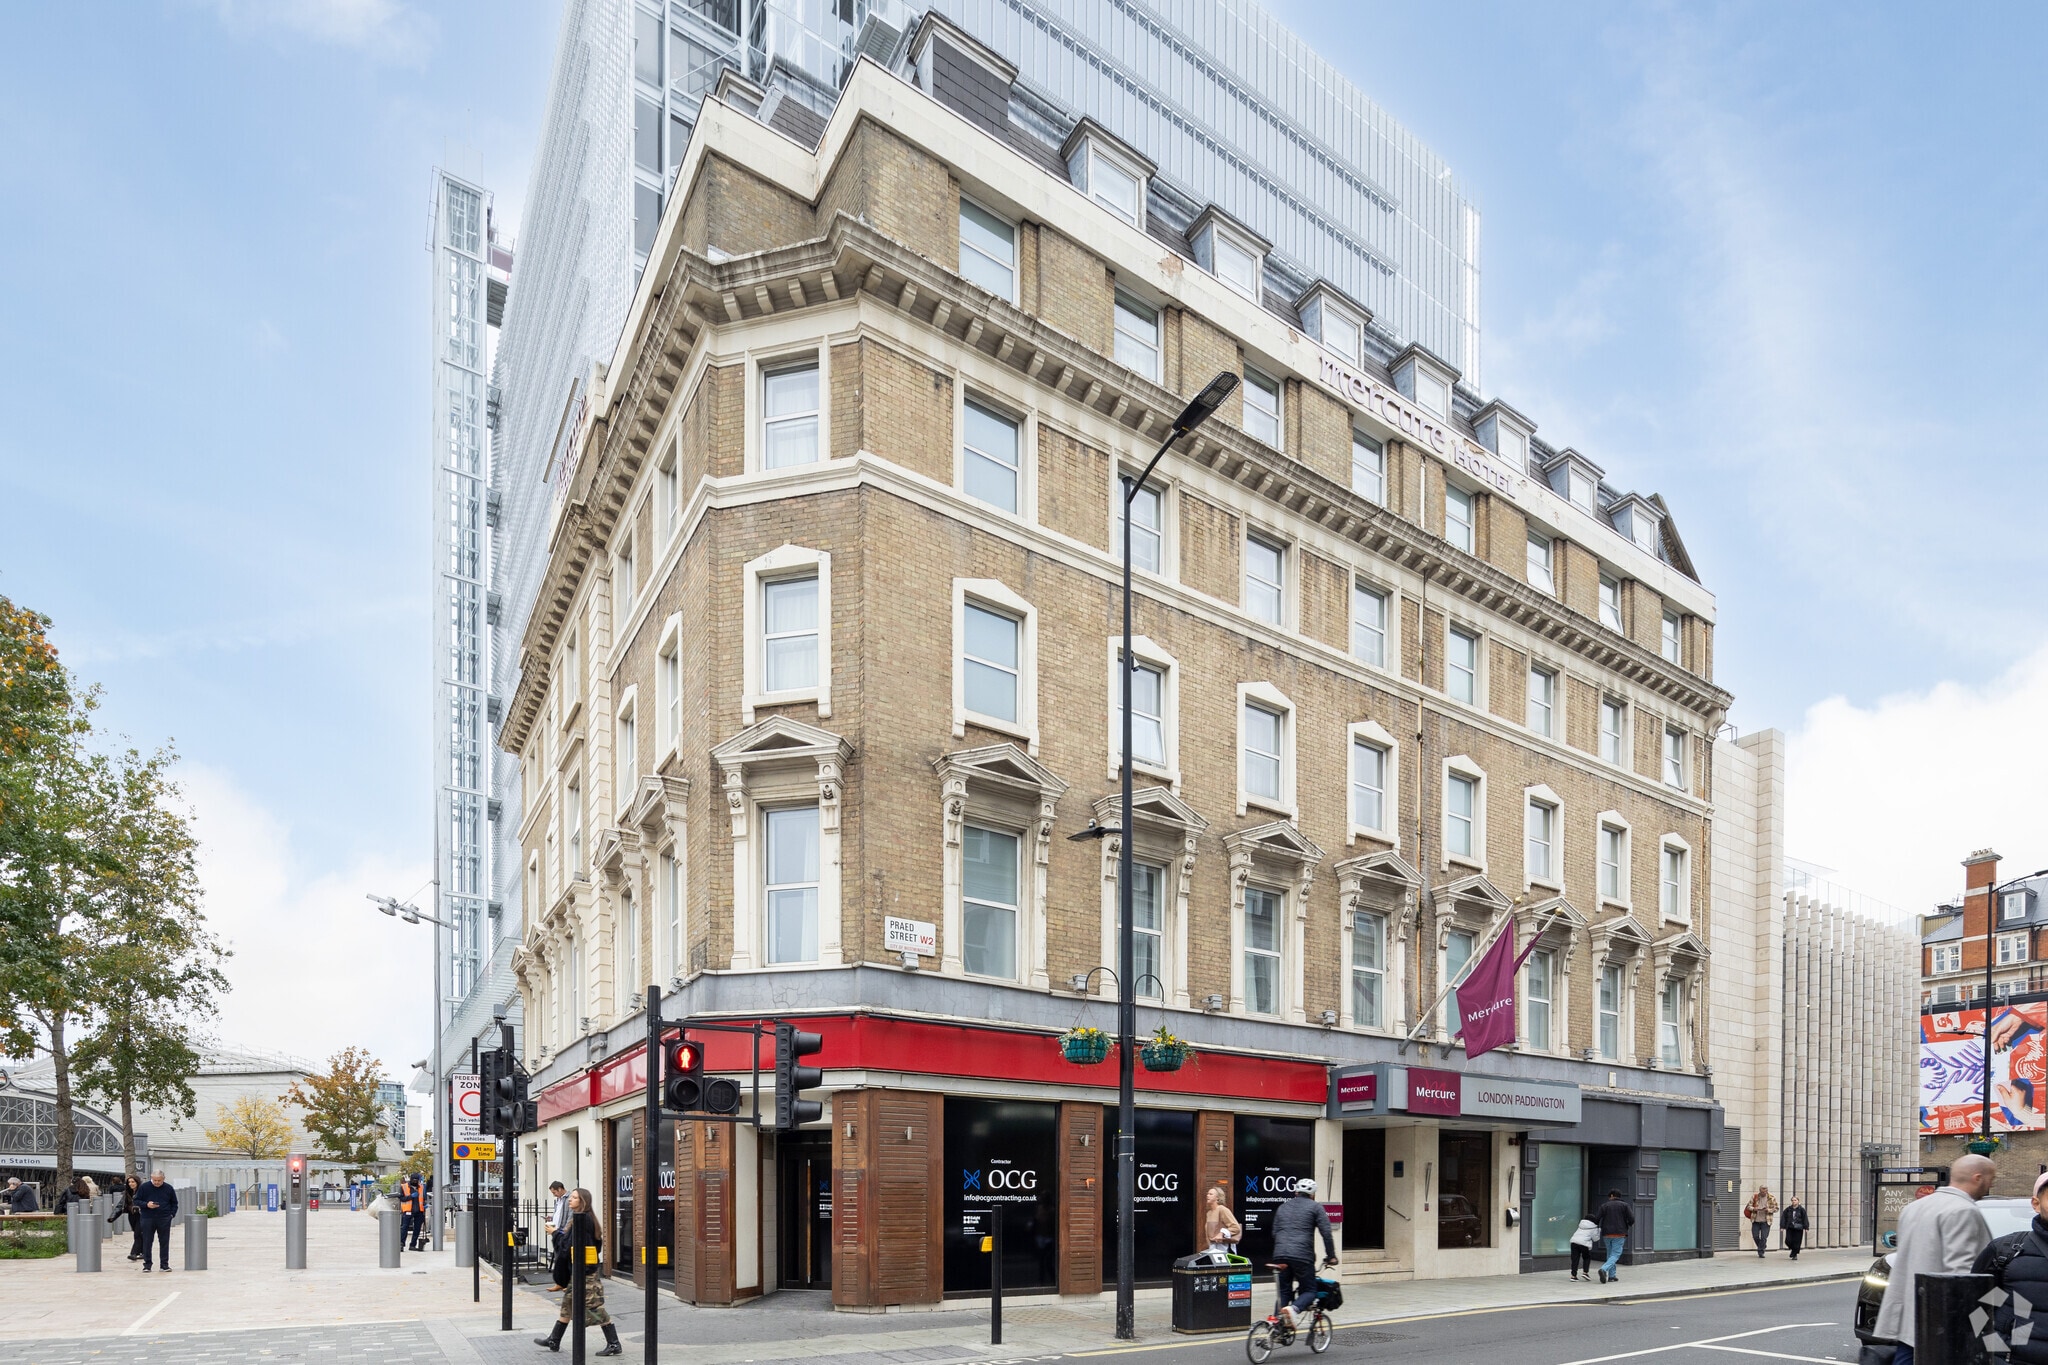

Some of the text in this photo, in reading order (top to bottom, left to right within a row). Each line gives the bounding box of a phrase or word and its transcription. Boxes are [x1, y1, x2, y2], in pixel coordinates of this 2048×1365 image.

[890, 920, 914, 932] PRAED
[890, 931, 934, 945] STREET W2
[1467, 996, 1513, 1023] Mercure
[1341, 1085, 1368, 1093] Mercure
[1416, 1085, 1456, 1101] Mercure
[1478, 1091, 1565, 1110] LONDON PADDINGTON
[661, 1171, 675, 1188] OCG
[988, 1169, 1038, 1190] OCG
[1137, 1172, 1179, 1191] OCG
[1263, 1175, 1297, 1192] OCG
[1133, 1195, 1179, 1203] cgcontracting.co.uk
[1246, 1196, 1297, 1204] info@ocgcontracting.c
